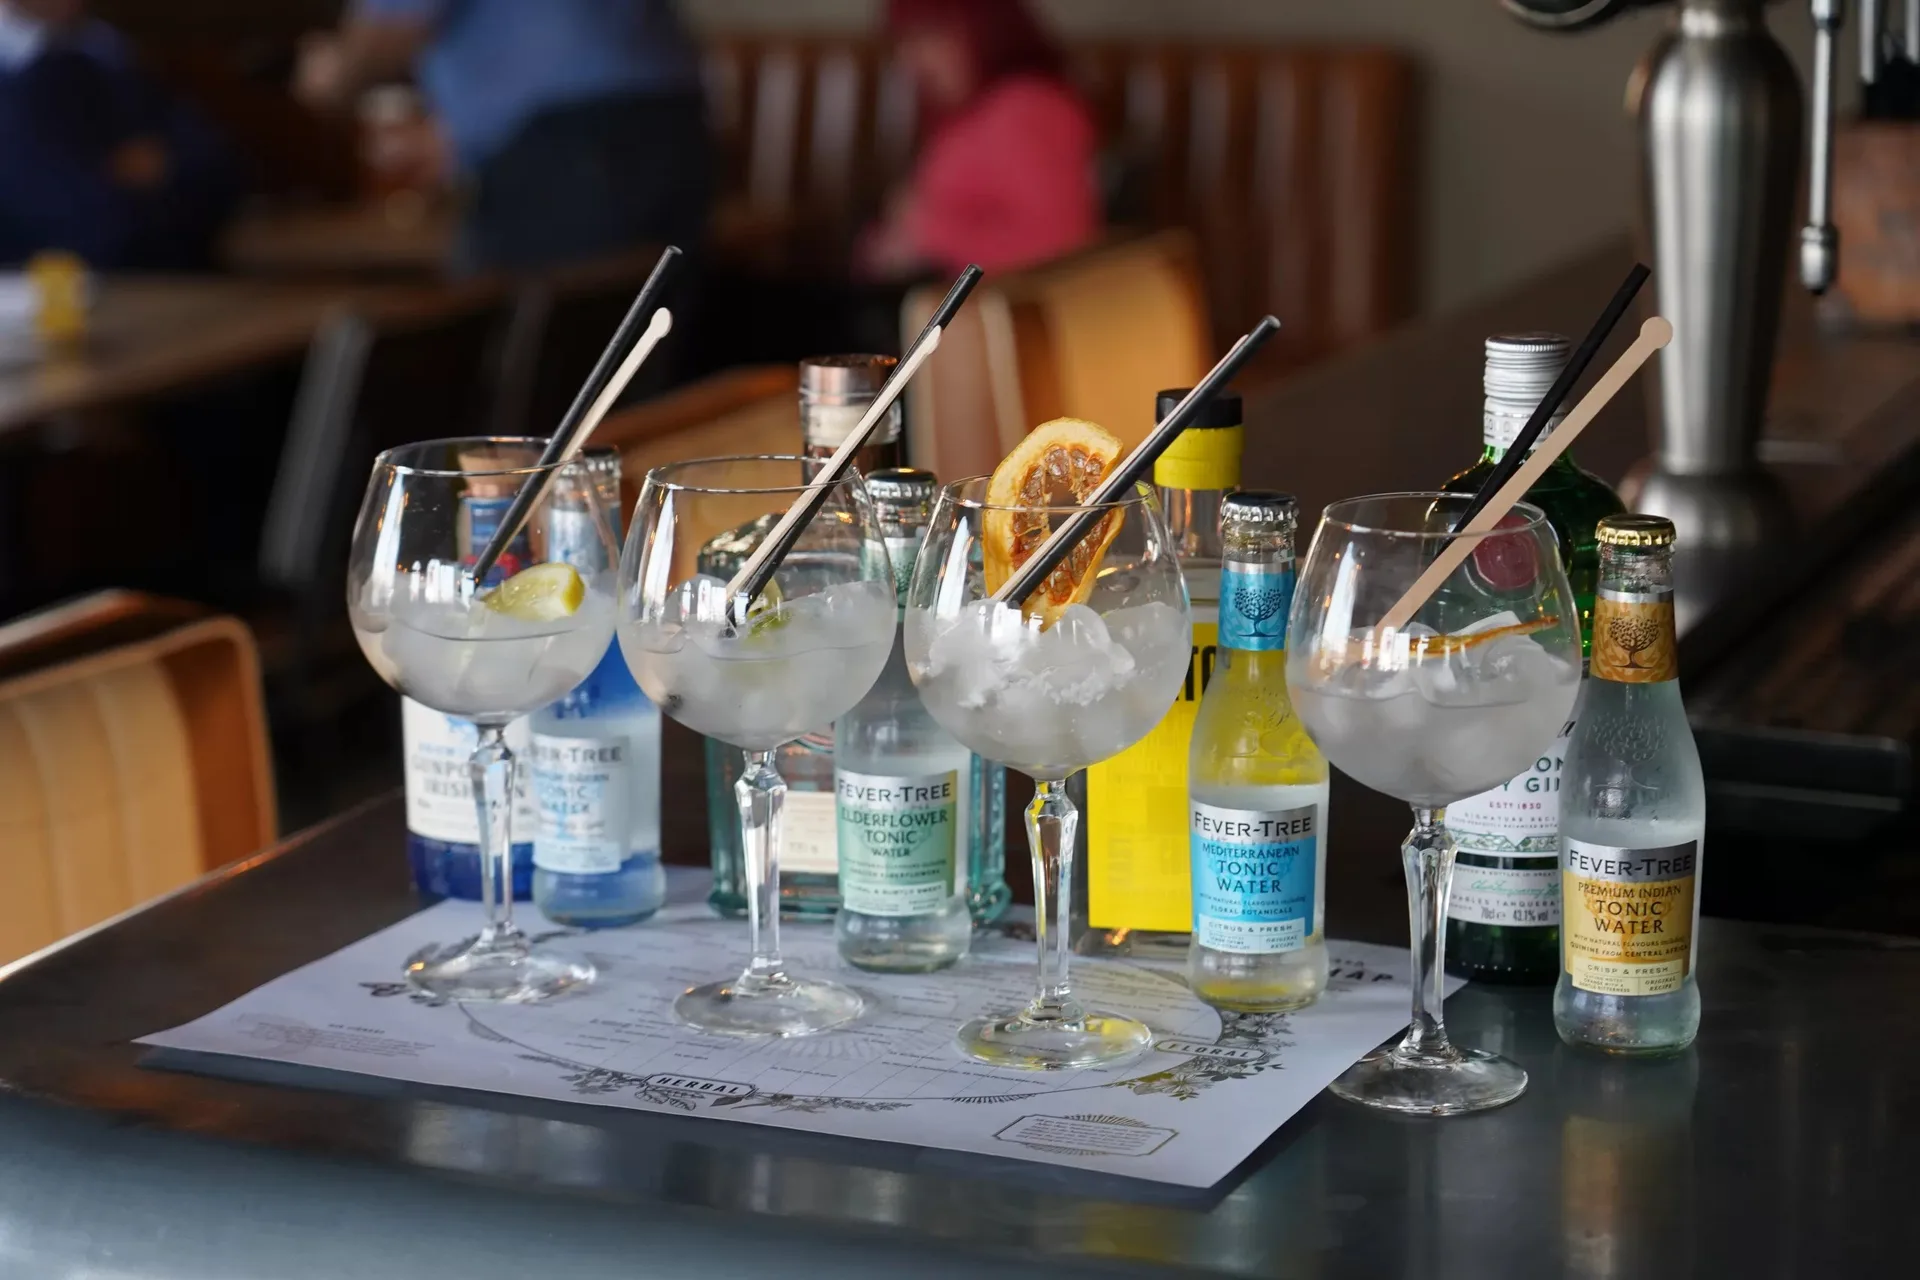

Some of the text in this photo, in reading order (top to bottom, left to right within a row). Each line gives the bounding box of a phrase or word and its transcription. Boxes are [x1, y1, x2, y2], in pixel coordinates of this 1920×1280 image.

[838, 778, 952, 802] FEVER-TREE
[841, 806, 949, 828] ELDERFLOWER
[1194, 811, 1312, 837] FEVER-TREE
[864, 829, 918, 845] TONIC
[871, 847, 911, 858] WATER
[1202, 843, 1300, 859] MEDITERRANEAN
[1217, 860, 1279, 876] TONIC
[1569, 849, 1692, 876] FEVER-TREE
[1216, 877, 1282, 894] WATER
[1578, 881, 1635, 898] PREMIUM
[1639, 883, 1682, 898] INDIAN
[1213, 896, 1241, 905] NATURAL
[1452, 893, 1489, 905] HARLES
[1210, 905, 1293, 915] FLORAL BOTANICALS
[1595, 899, 1662, 916] TONIC
[1208, 921, 1243, 933] CITRUS
[1259, 924, 1293, 933] FRESH
[1593, 917, 1664, 935] WATER
[1574, 933, 1588, 942] WITH
[1589, 937, 1621, 947] NATURAL
[1570, 941, 1688, 958] QUININE FROM CENTRAL AFRICA
[1587, 963, 1618, 974] CRISP
[1635, 966, 1669, 975] FRESH
[1645, 976, 1676, 985] ORIGINAL
[1649, 984, 1672, 992] RECIPE
[1166, 1041, 1251, 1059] FLORAL
[656, 1076, 740, 1095] HERBAL
